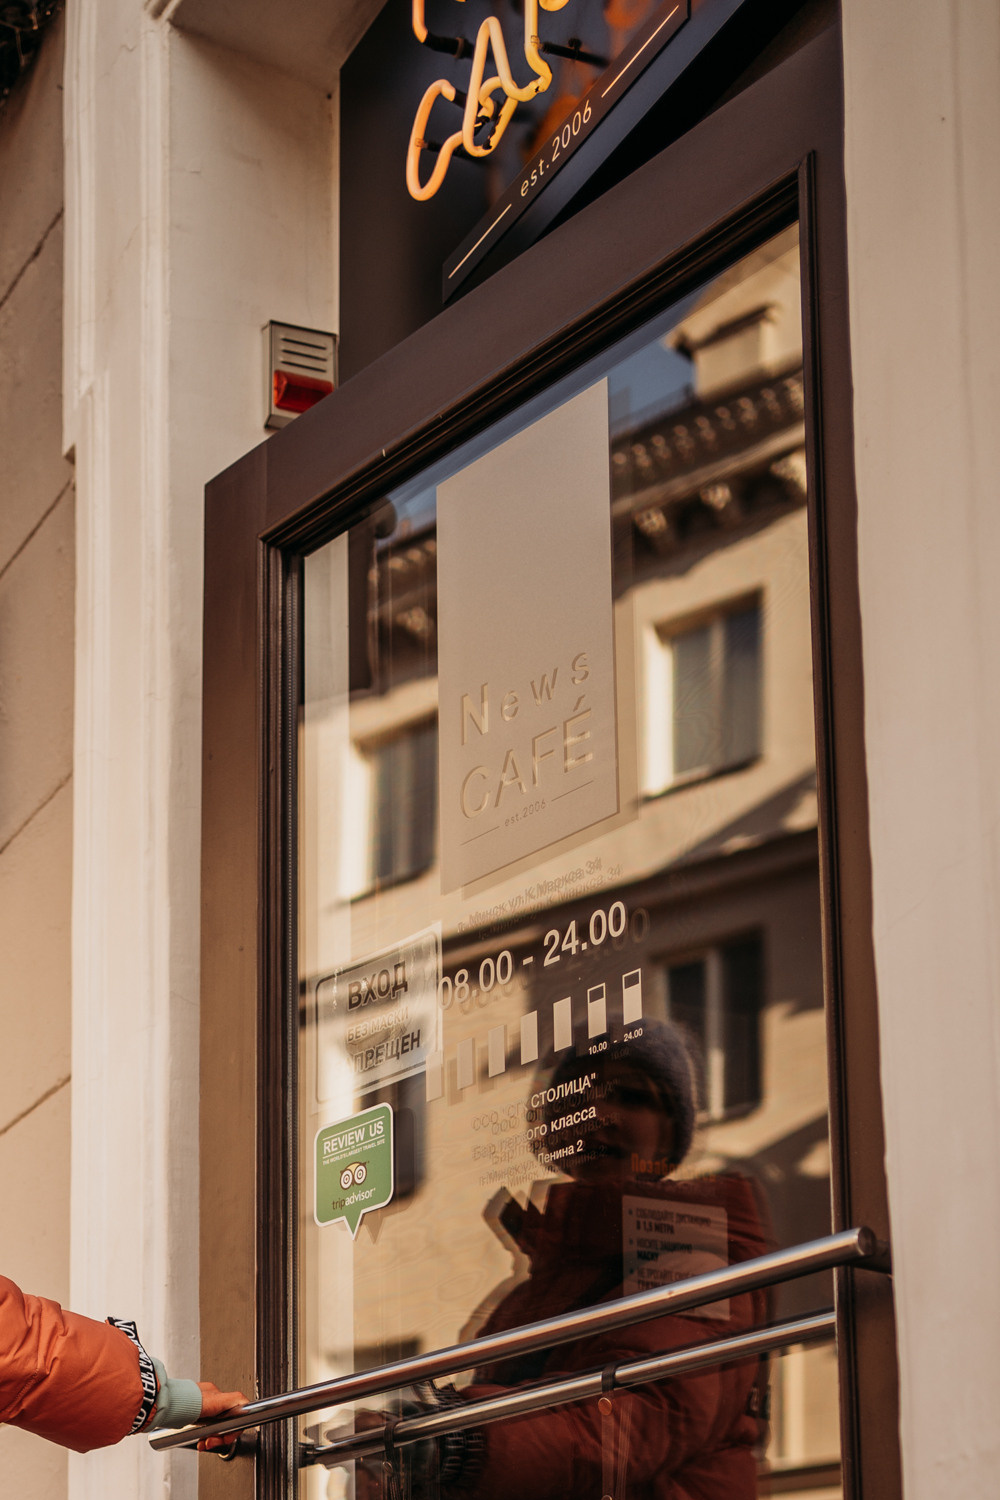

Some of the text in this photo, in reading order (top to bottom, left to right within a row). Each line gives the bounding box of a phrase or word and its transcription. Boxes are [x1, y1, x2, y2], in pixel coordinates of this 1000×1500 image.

[520, 99, 592, 197] est.2006
[461, 652, 590, 746] News
[460, 694, 594, 819] CAFÉ
[437, 950, 513, 1010] 08.00
[543, 901, 627, 967] 24.00
[347, 961, 408, 1012] ВХОД
[347, 1006, 410, 1042] БЕЗ МАСКИ
[588, 1041, 608, 1056] 10.00
[623, 1028, 644, 1042] 24.00
[350, 1029, 421, 1074] ПРЕЩЕН
[323, 1120, 384, 1155] REVIEW US
[550, 1105, 597, 1132] класса
[576, 1139, 584, 1152] 2
[332, 1188, 374, 1210] tripadvisor
